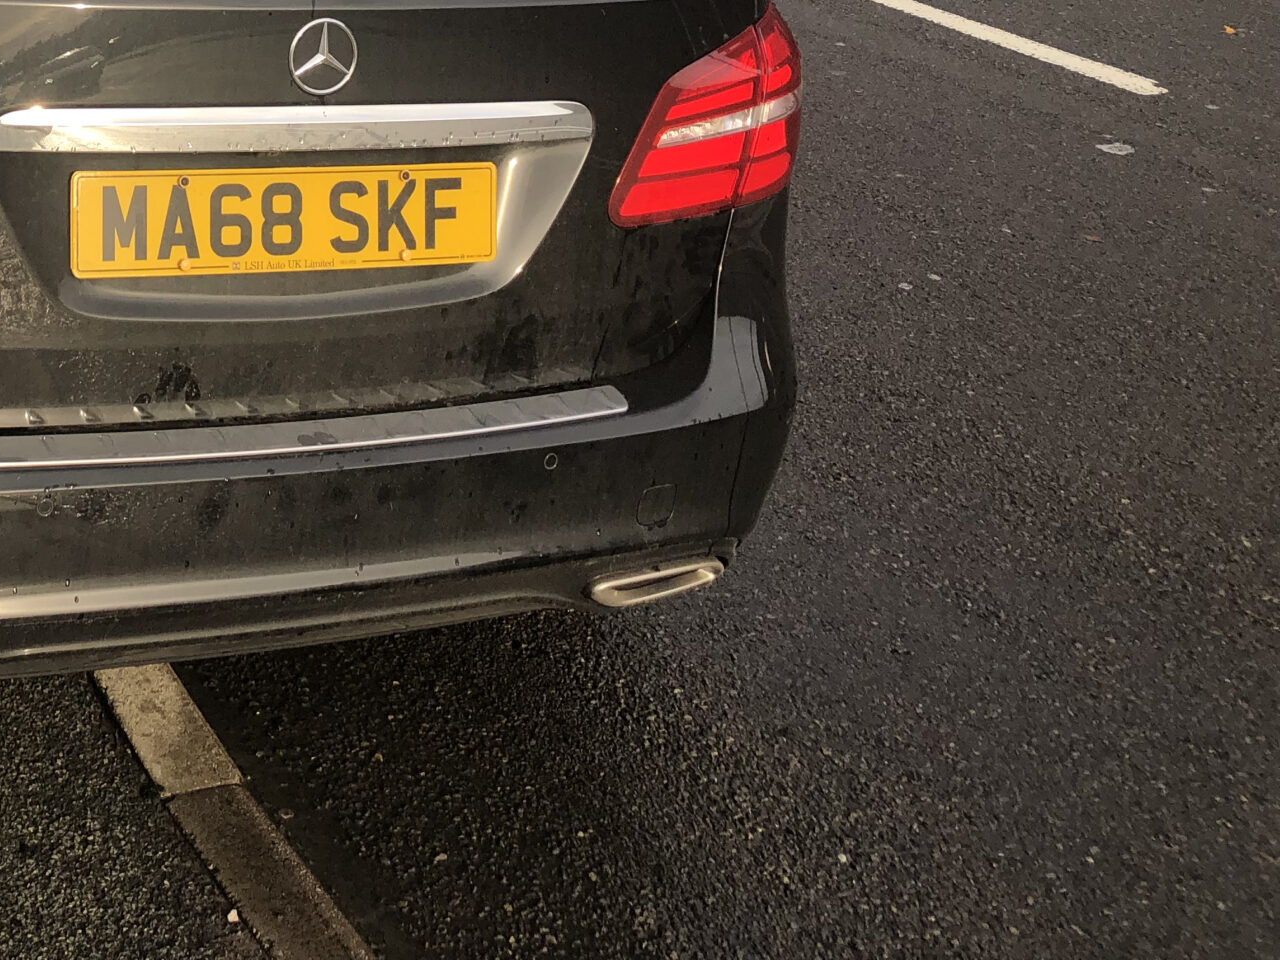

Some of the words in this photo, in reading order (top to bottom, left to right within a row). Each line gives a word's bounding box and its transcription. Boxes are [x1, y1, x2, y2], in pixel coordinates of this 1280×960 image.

[102, 182, 303, 262] MA68
[329, 176, 462, 254] SKF
[244, 261, 263, 271] LSH
[265, 260, 285, 270] Auto
[288, 259, 302, 269] UK
[304, 257, 335, 268] Limited
